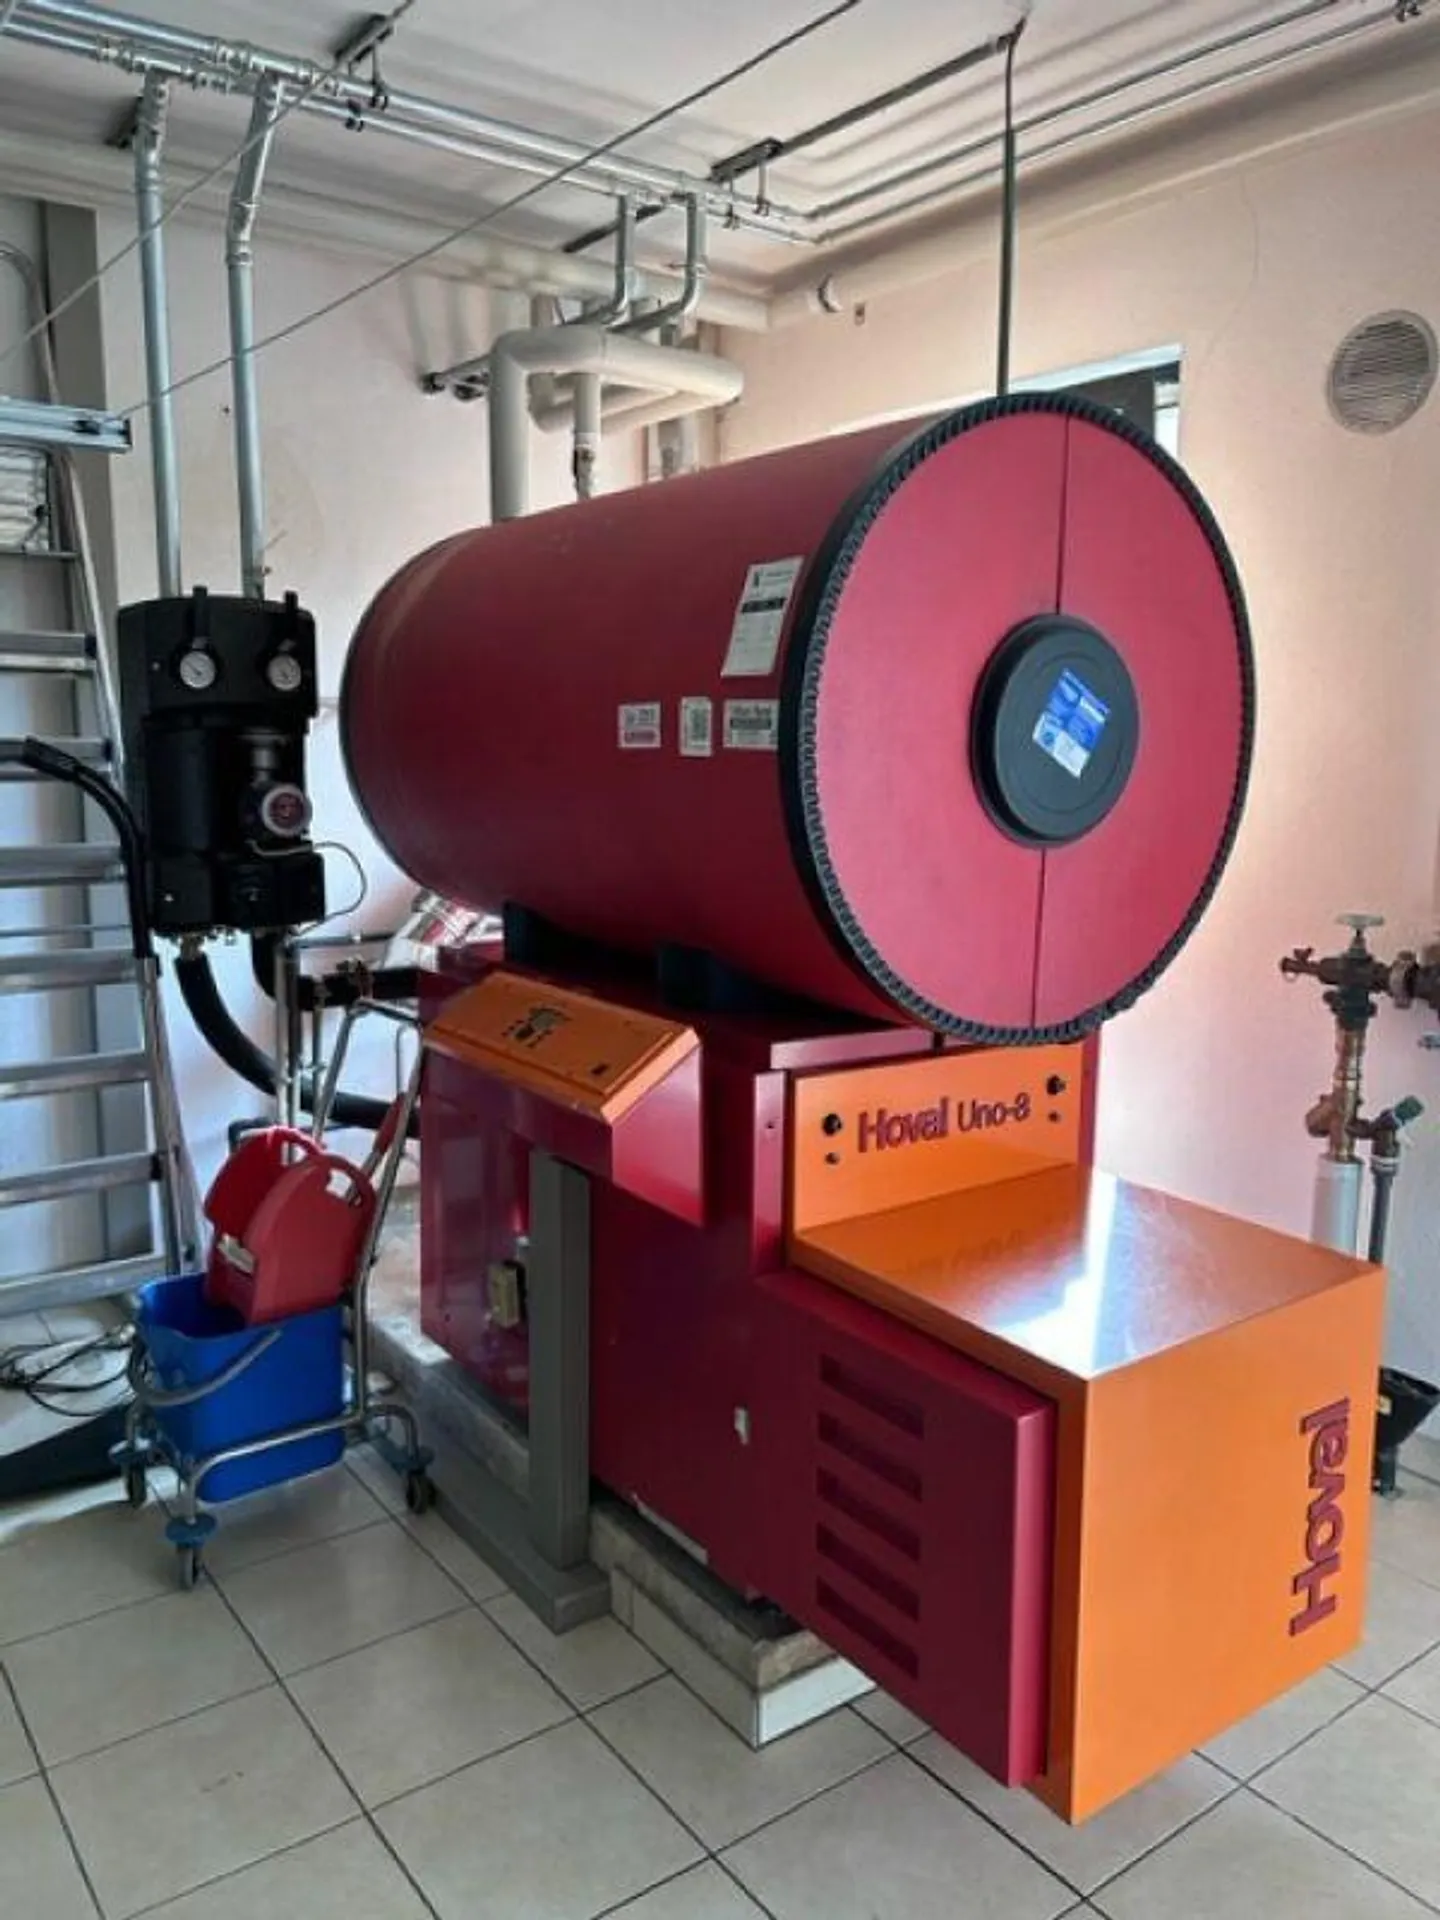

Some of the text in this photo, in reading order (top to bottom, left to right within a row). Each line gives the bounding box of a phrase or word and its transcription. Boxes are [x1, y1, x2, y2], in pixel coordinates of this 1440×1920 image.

[858, 1092, 1031, 1153] Hoval Uno-8
[1289, 1396, 1350, 1637] Hoval
